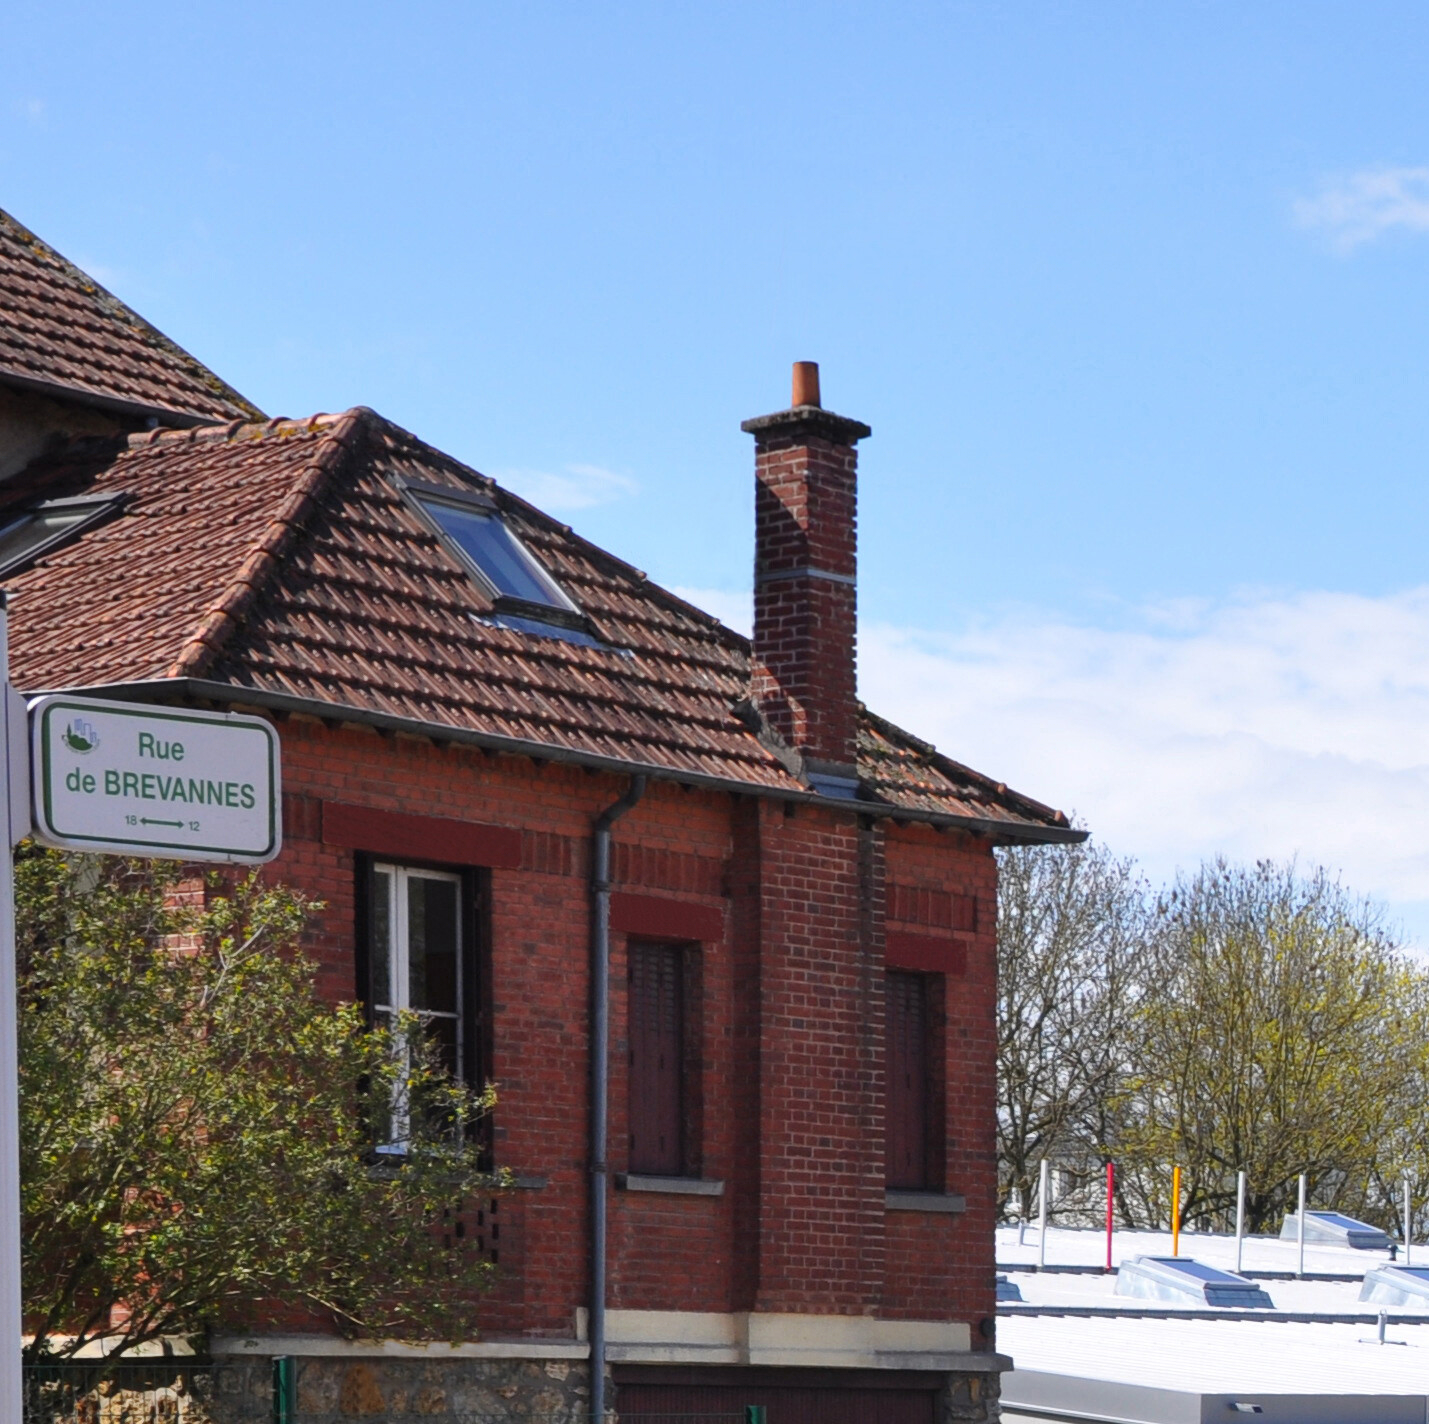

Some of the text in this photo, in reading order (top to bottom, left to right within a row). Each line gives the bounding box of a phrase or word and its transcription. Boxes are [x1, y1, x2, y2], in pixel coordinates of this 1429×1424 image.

[138, 732, 185, 762] Rue
[66, 767, 255, 810] de BREVANNES
[125, 815, 200, 832] 18 12
